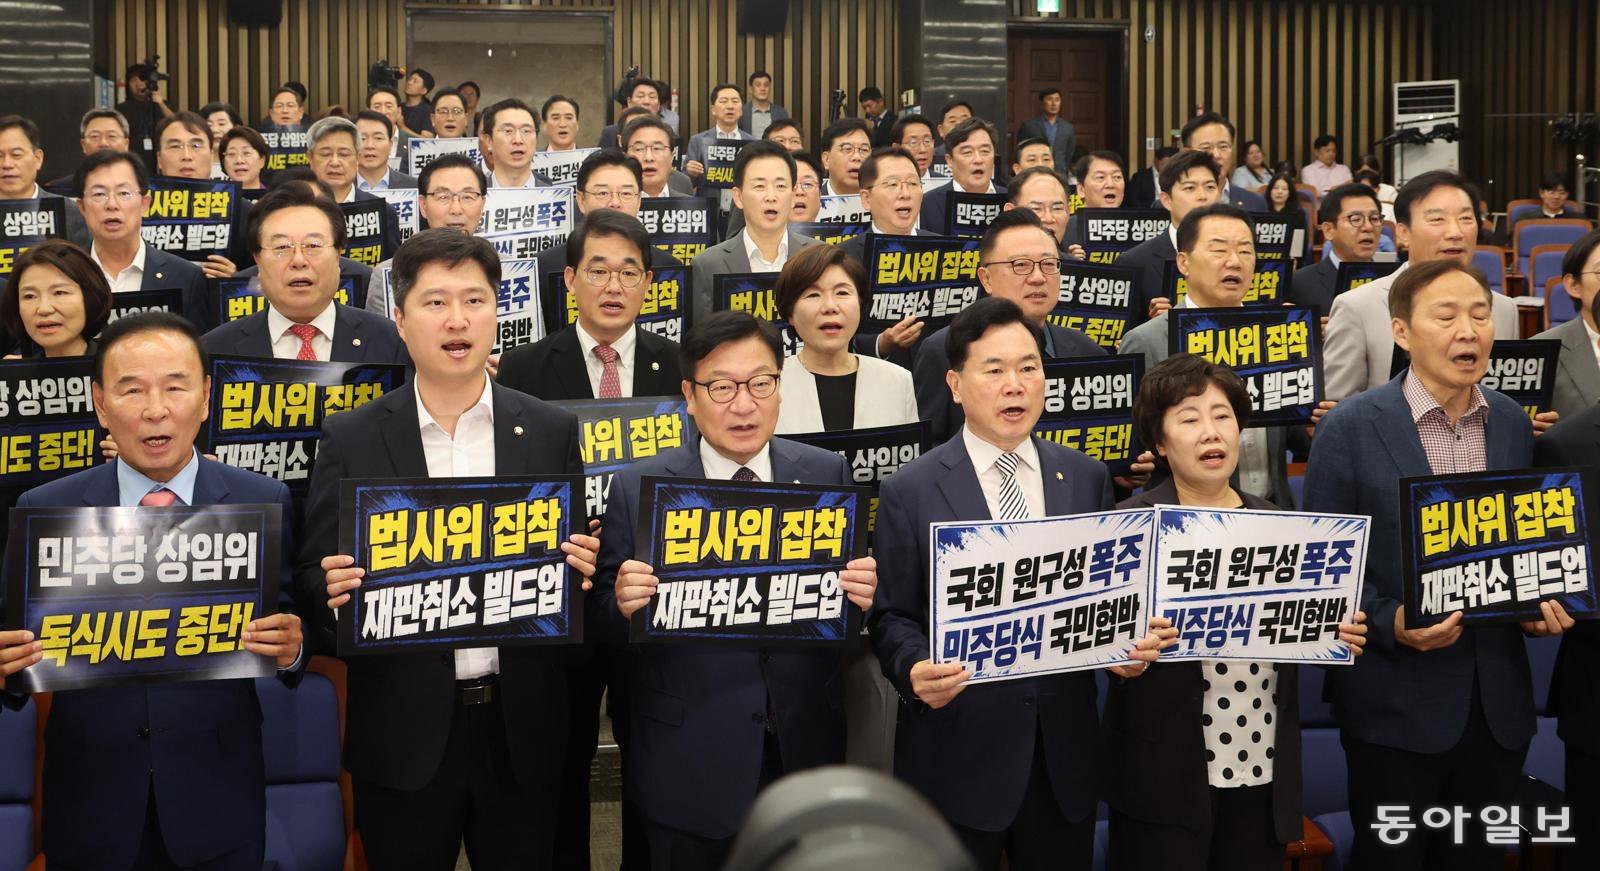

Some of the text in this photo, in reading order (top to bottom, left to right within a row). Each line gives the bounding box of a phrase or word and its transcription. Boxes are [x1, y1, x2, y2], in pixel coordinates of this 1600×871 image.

[552, 162, 580, 181] 원구성
[708, 145, 736, 161] 민주당
[3, 211, 56, 237] 상임위
[193, 191, 230, 218] 집착
[494, 205, 535, 232] 원구성
[537, 201, 566, 228] 폭주
[662, 209, 707, 233] 상임위
[956, 203, 1001, 226] 민주당
[142, 223, 231, 250] 판취소 빌드업
[1088, 219, 1130, 241] 민주당
[878, 250, 980, 285] 법사위 집착
[869, 286, 979, 320] 재판취소 빌드업
[1079, 277, 1132, 308] 상임위
[1187, 321, 1309, 367] 법사위 집착
[15, 375, 94, 417] 상임위
[221, 381, 317, 430] 법사위
[1070, 373, 1133, 411] 상임위
[1263, 366, 1315, 412] 빌드업
[38, 429, 95, 471] 중단!
[629, 413, 682, 459] 집착
[1084, 423, 1133, 461] 중단!
[369, 498, 562, 572] 법사위 집착
[664, 507, 773, 565] 법사위
[780, 507, 847, 561] 집착
[1421, 487, 1576, 557] 법사위 집착
[38, 531, 258, 588] 민주당 상임위
[946, 533, 1144, 612] 국회 원구성 폭주
[1167, 540, 1356, 592] 국회 원구성 폭주
[1421, 544, 1589, 615] 재판취소 빌드업
[361, 562, 565, 640] 재판취소 빌드업
[652, 570, 844, 630] 재판취소 빌드업
[1258, 597, 1348, 645] 국민협박
[40, 602, 255, 667] 독식시도 중단!
[943, 593, 1140, 672] 민주당식 국민협박
